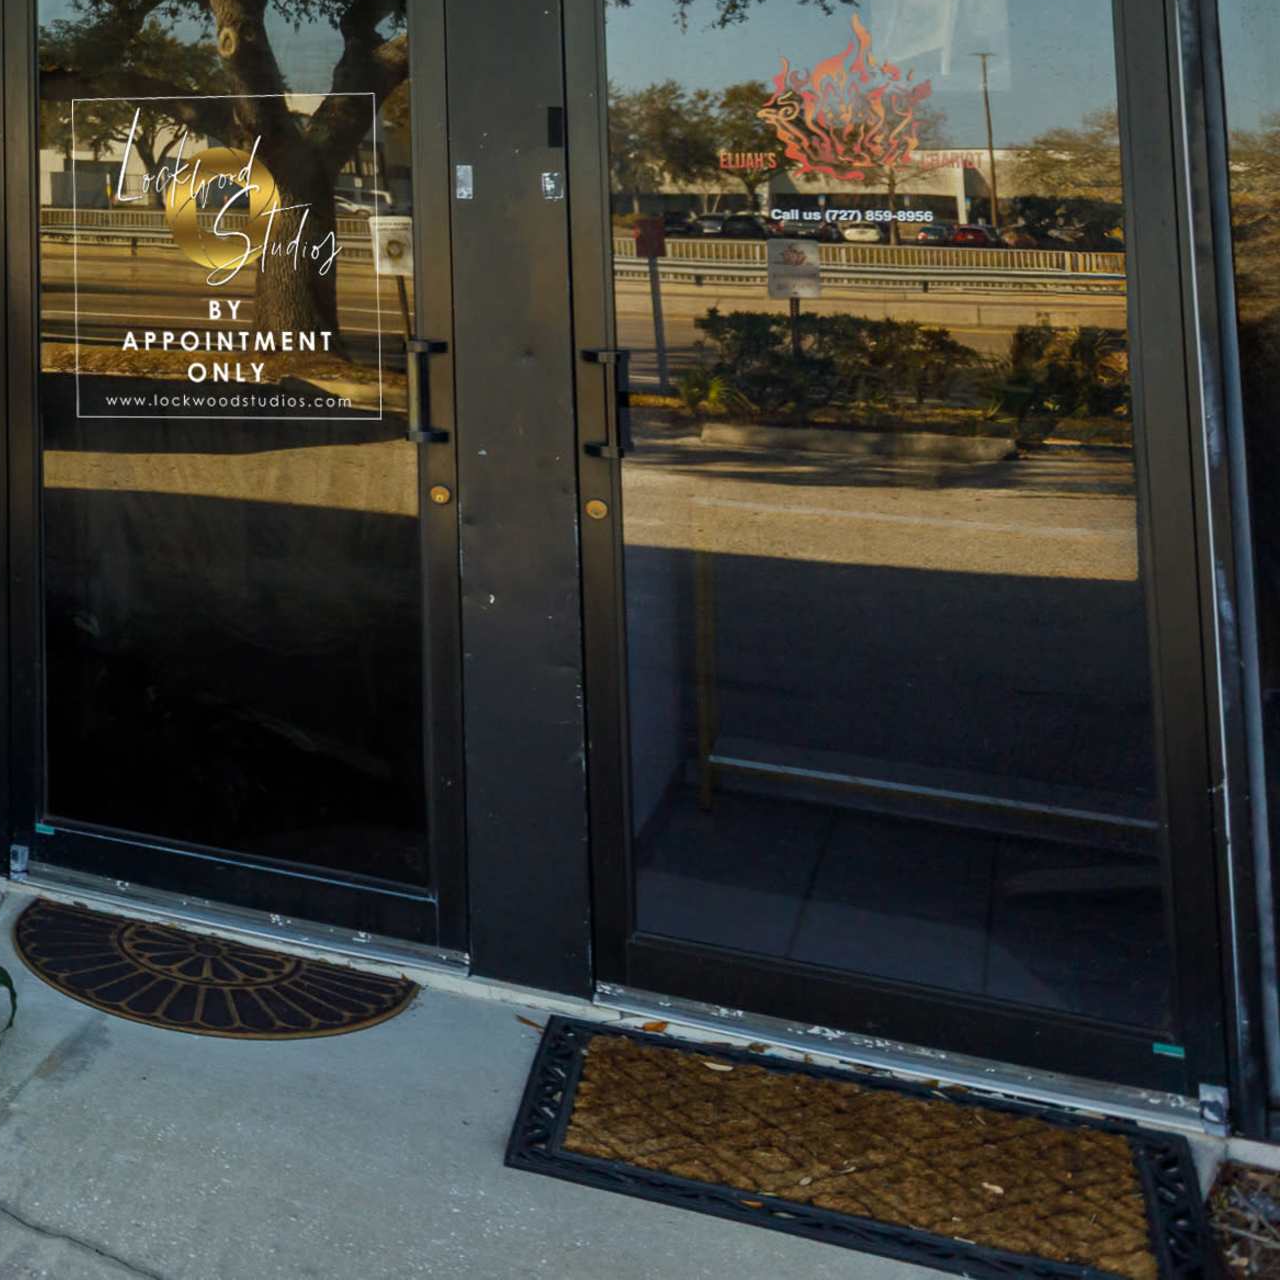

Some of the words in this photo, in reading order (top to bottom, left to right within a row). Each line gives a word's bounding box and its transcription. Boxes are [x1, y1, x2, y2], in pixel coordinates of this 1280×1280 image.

[117, 107, 262, 209] Lockwood
[719, 152, 778, 170] ELIJAH'S
[771, 208, 799, 220] Call
[803, 210, 821, 221] us
[825, 209, 862, 222] (727)
[865, 210, 934, 222] 859-8956
[206, 184, 343, 287] Studios
[208, 300, 241, 320] BY
[122, 330, 333, 352] APPOINTMENT
[187, 362, 265, 383] ONLY
[105, 393, 352, 409] www.lockwoodstudios.com
